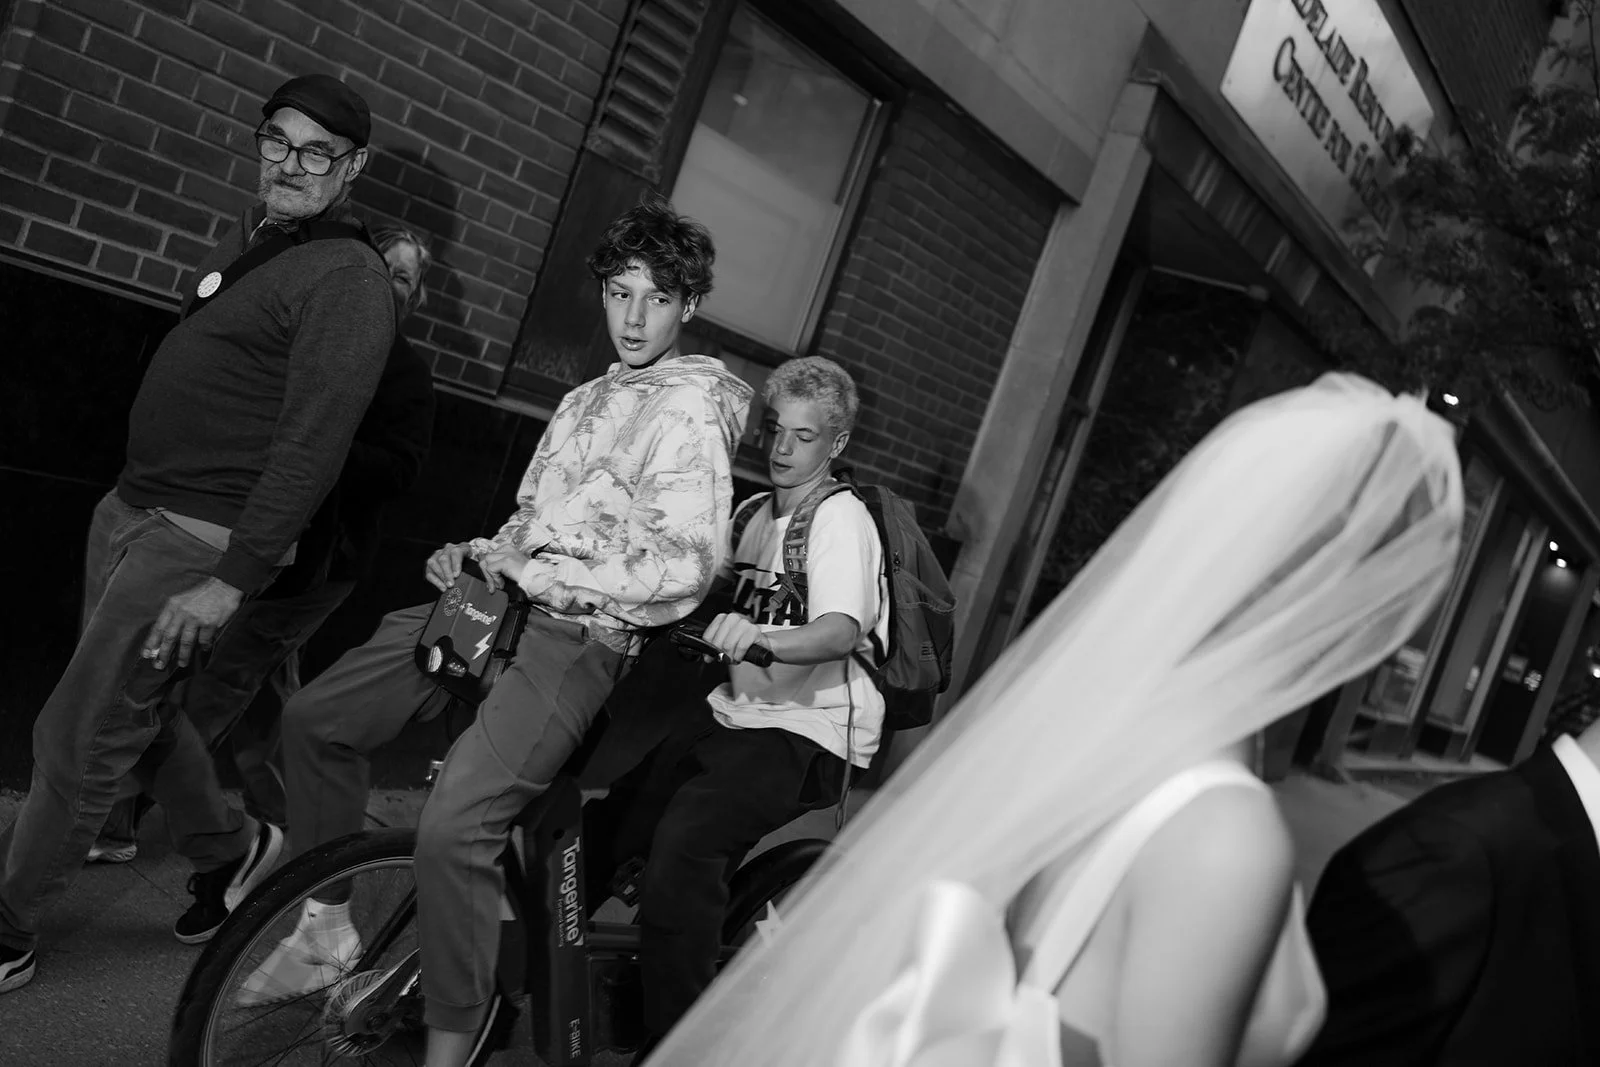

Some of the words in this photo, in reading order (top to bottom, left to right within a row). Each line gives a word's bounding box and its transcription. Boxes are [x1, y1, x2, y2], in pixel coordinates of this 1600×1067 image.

[1290, 0, 1356, 86] DELAIDE
[464, 602, 493, 625] Tangerine
[560, 837, 582, 942] Tangerine
[569, 1017, 581, 1059] E-BIKE
